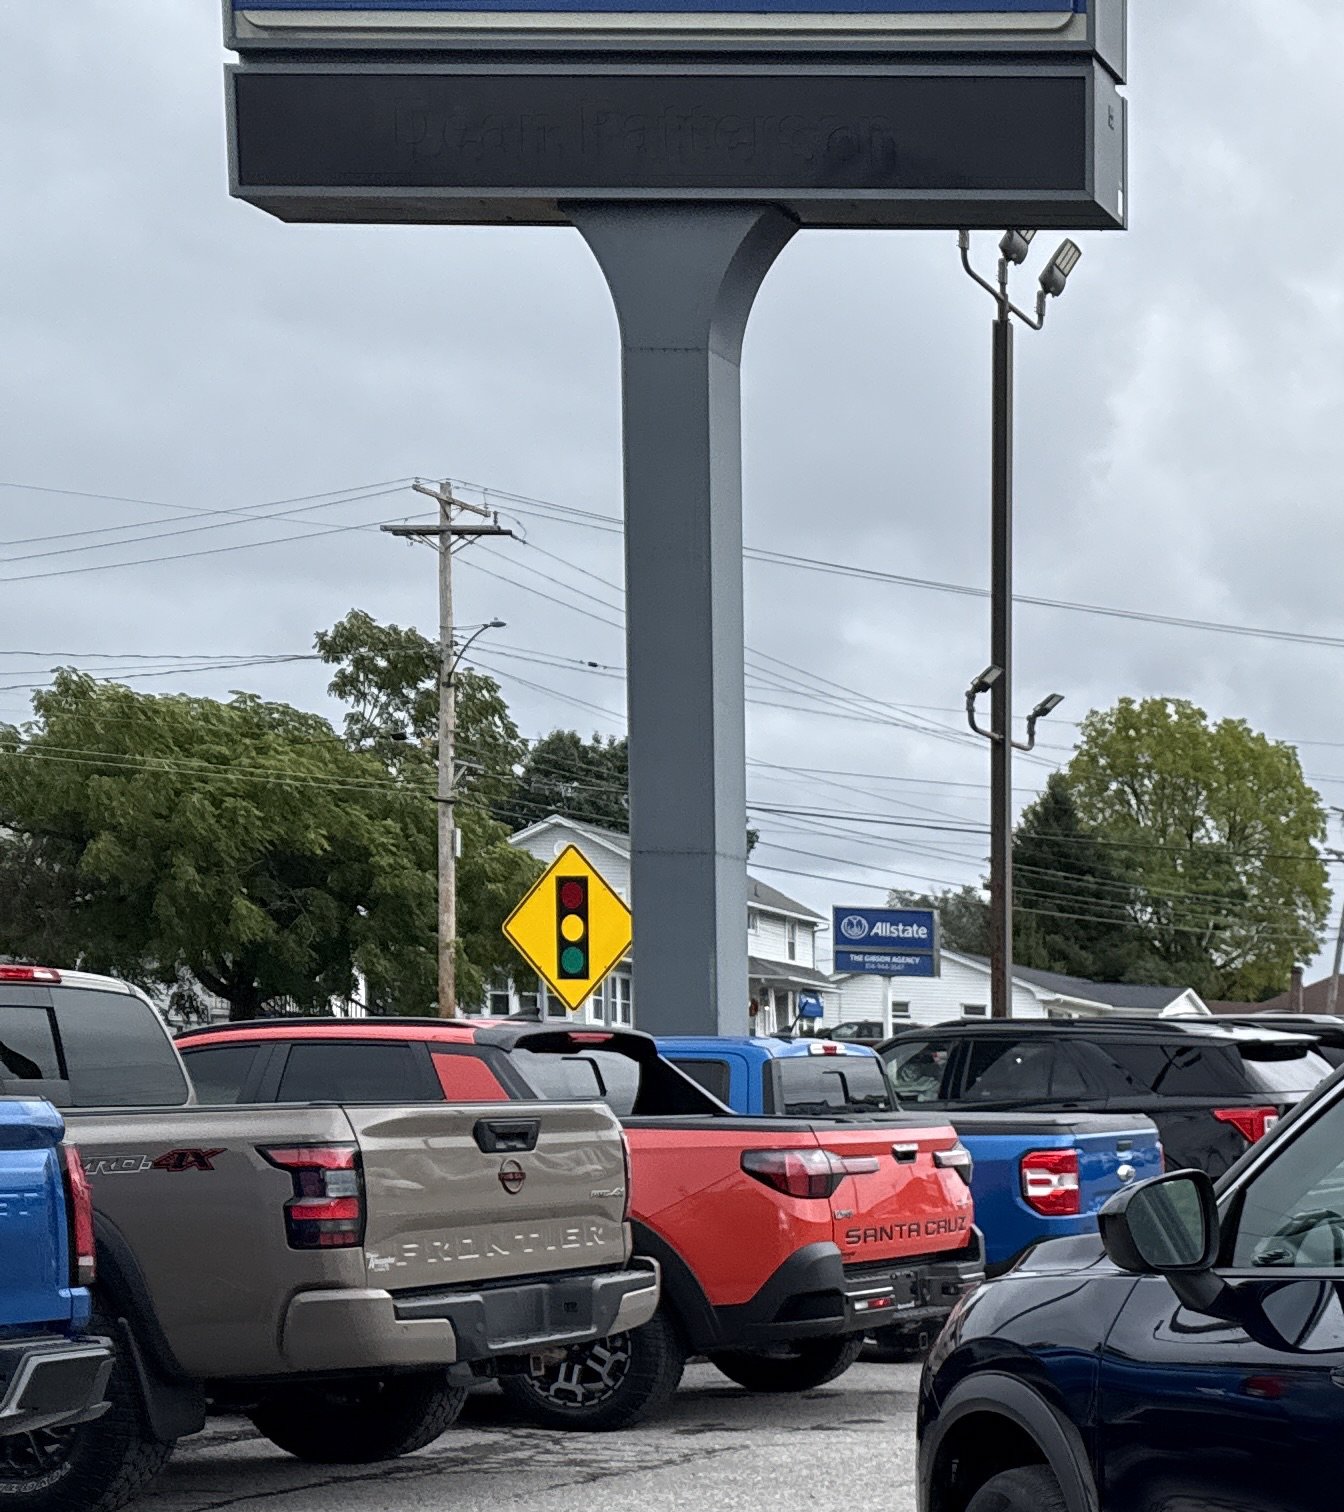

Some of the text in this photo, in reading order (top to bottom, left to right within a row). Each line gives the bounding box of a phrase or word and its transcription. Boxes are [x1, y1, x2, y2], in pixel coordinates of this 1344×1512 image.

[870, 921, 928, 938] Allstate
[845, 1216, 967, 1245] SANTA CRUZ
[396, 1226, 606, 1267] FRONTIER
